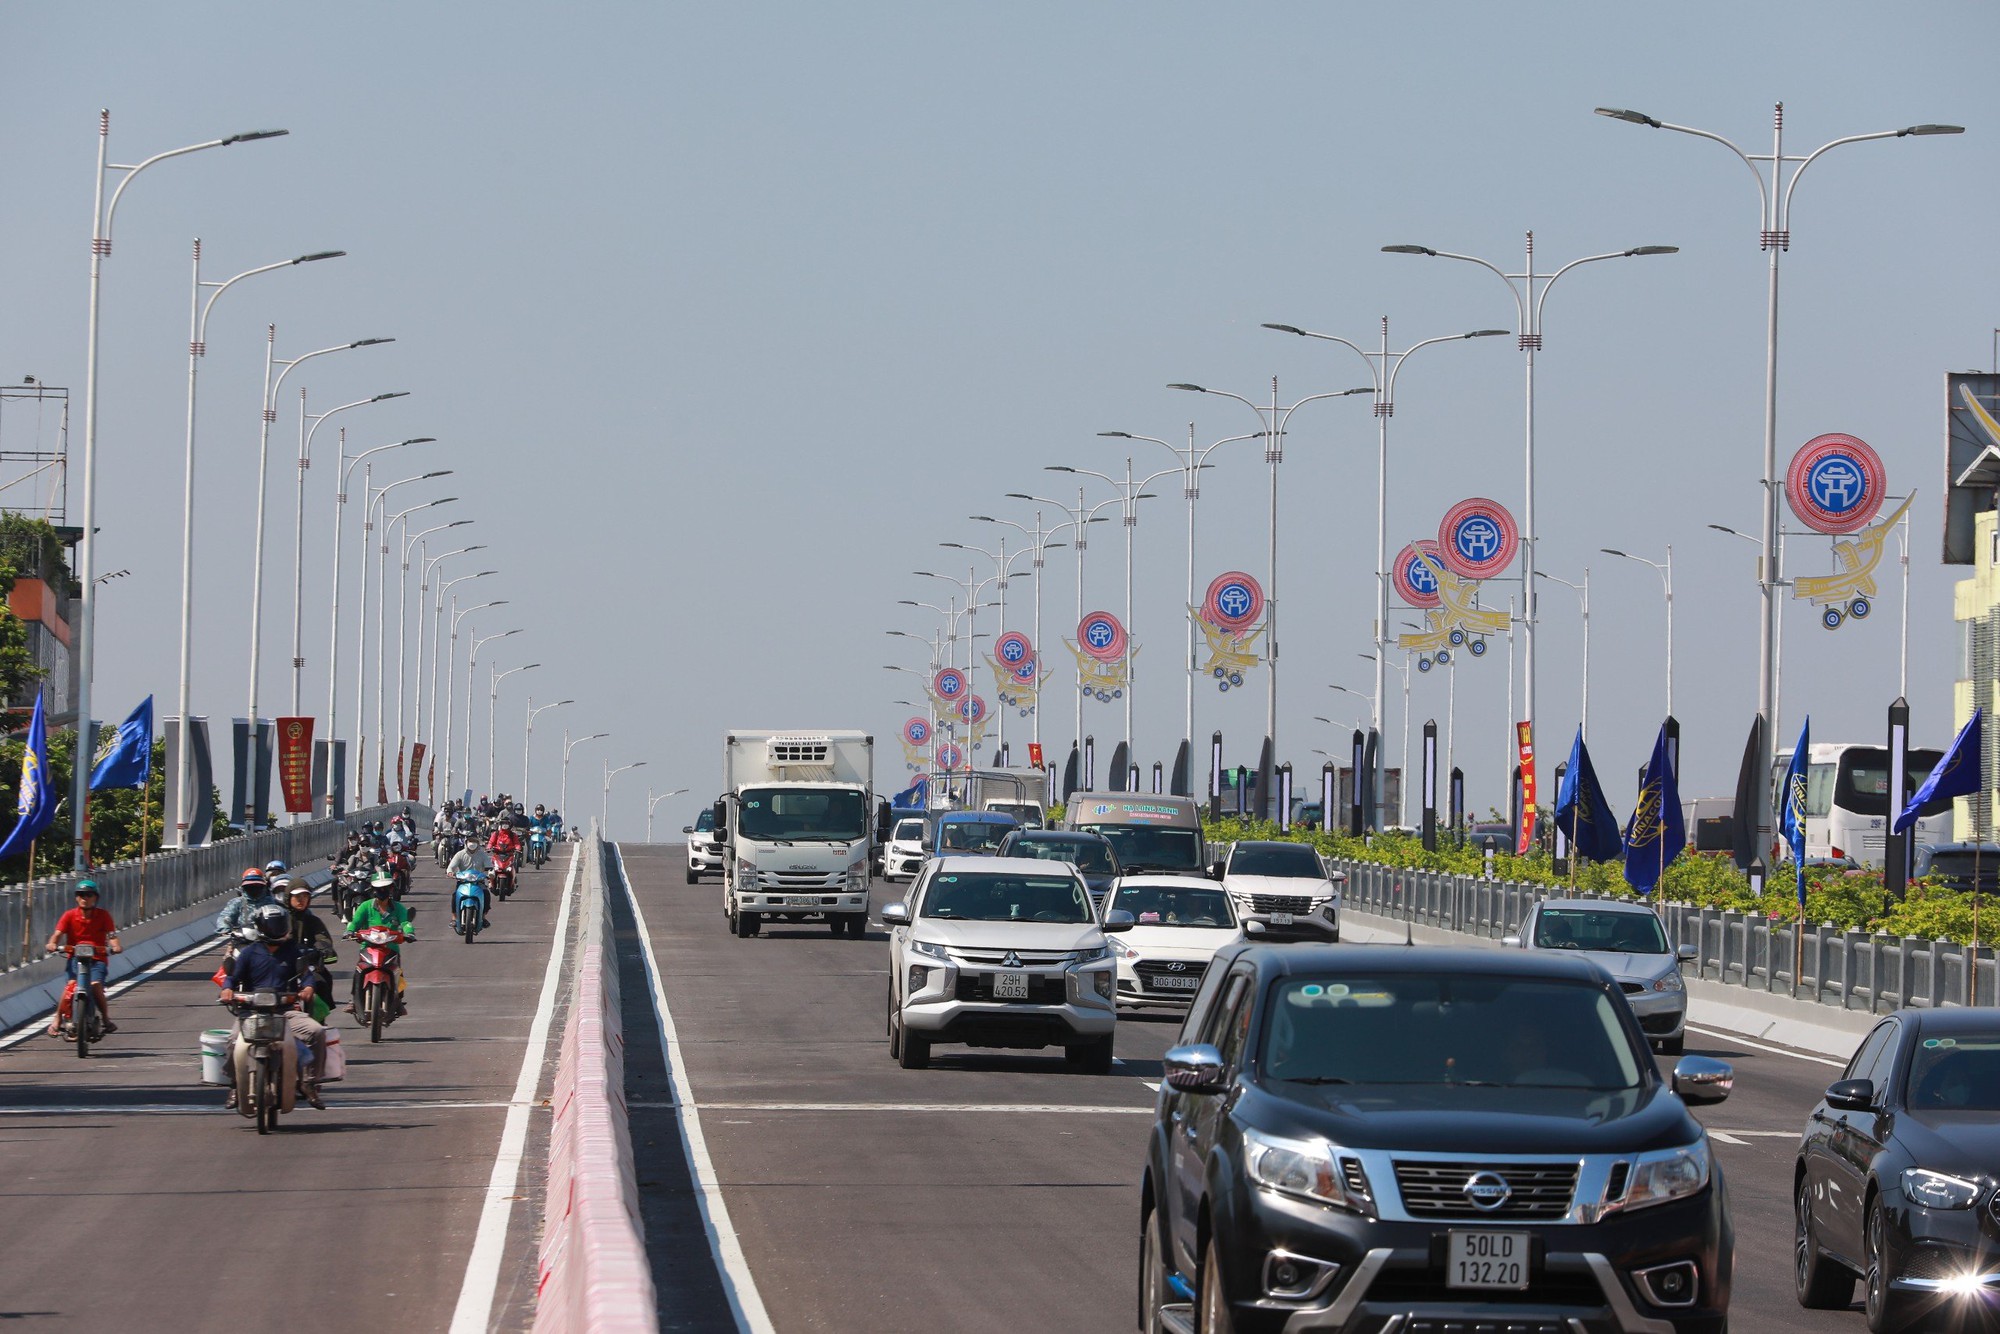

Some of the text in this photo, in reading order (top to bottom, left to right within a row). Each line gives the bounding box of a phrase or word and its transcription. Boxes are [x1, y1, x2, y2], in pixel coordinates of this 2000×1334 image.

[1630, 796, 1662, 839] VINACO
[994, 985, 1027, 997] 420.52
[1002, 974, 1021, 986] 29H
[1466, 1235, 1513, 1258] 50LD
[1459, 1261, 1520, 1284] 132.20
